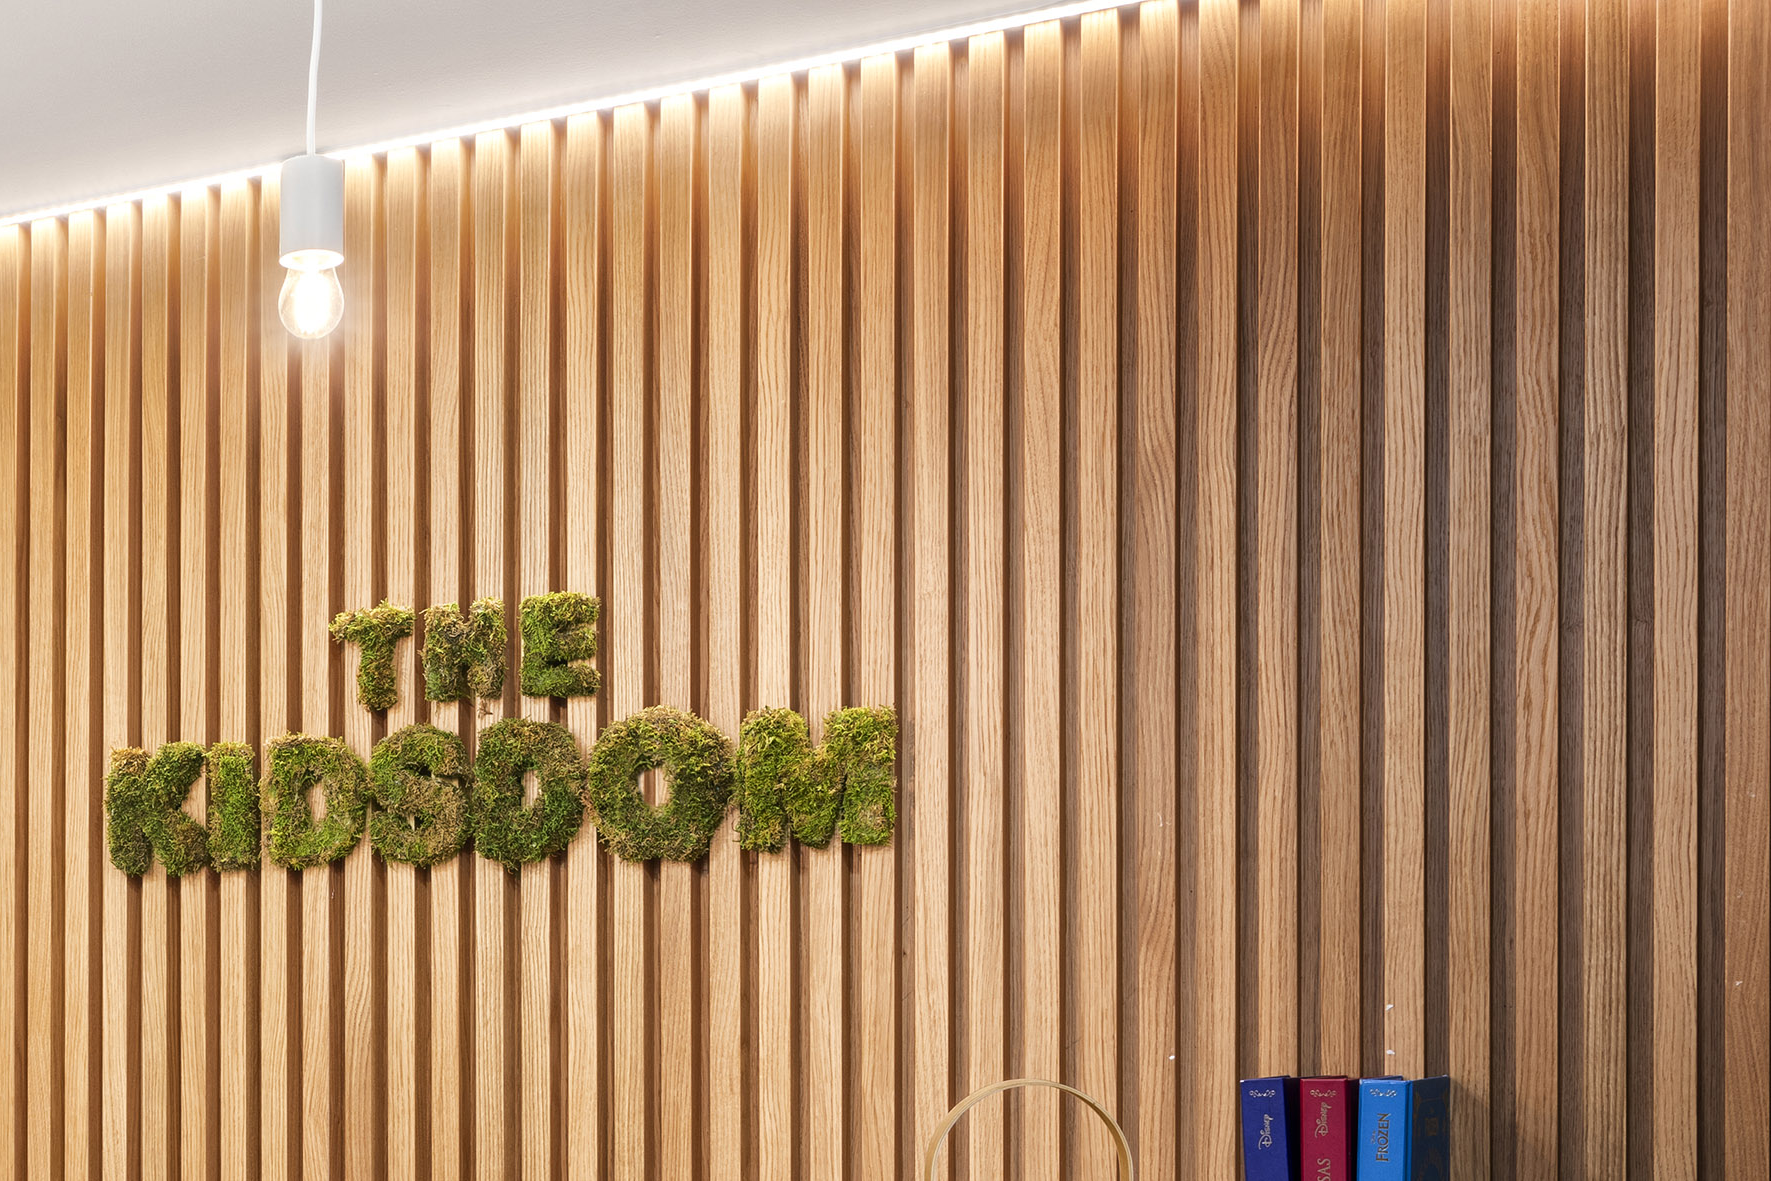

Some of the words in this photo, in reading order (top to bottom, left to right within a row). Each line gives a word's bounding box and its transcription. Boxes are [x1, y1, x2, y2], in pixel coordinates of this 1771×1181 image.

[329, 591, 602, 711] THE
[1258, 1114, 1274, 1150] Disney
[1314, 1102, 1332, 1138] Disney
[1376, 1112, 1391, 1162] FROZEN
